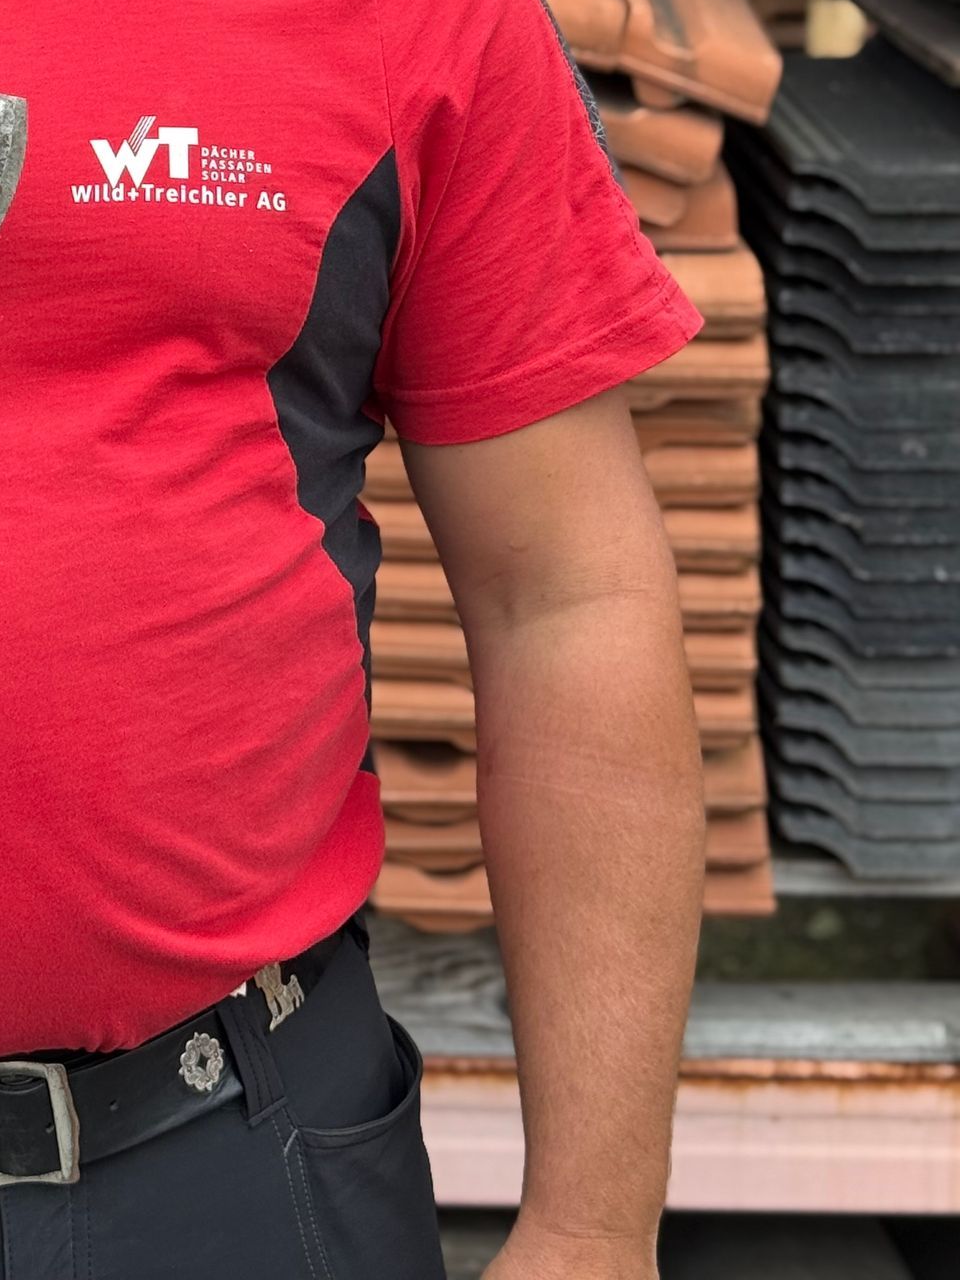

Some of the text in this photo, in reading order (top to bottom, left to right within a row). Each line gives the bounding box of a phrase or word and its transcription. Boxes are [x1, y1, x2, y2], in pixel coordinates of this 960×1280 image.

[90, 116, 199, 189] WT
[201, 145, 255, 160] DÄCHER
[201, 158, 272, 174] FASSADEN
[201, 170, 246, 183] SOLAR
[256, 192, 287, 212] AG
